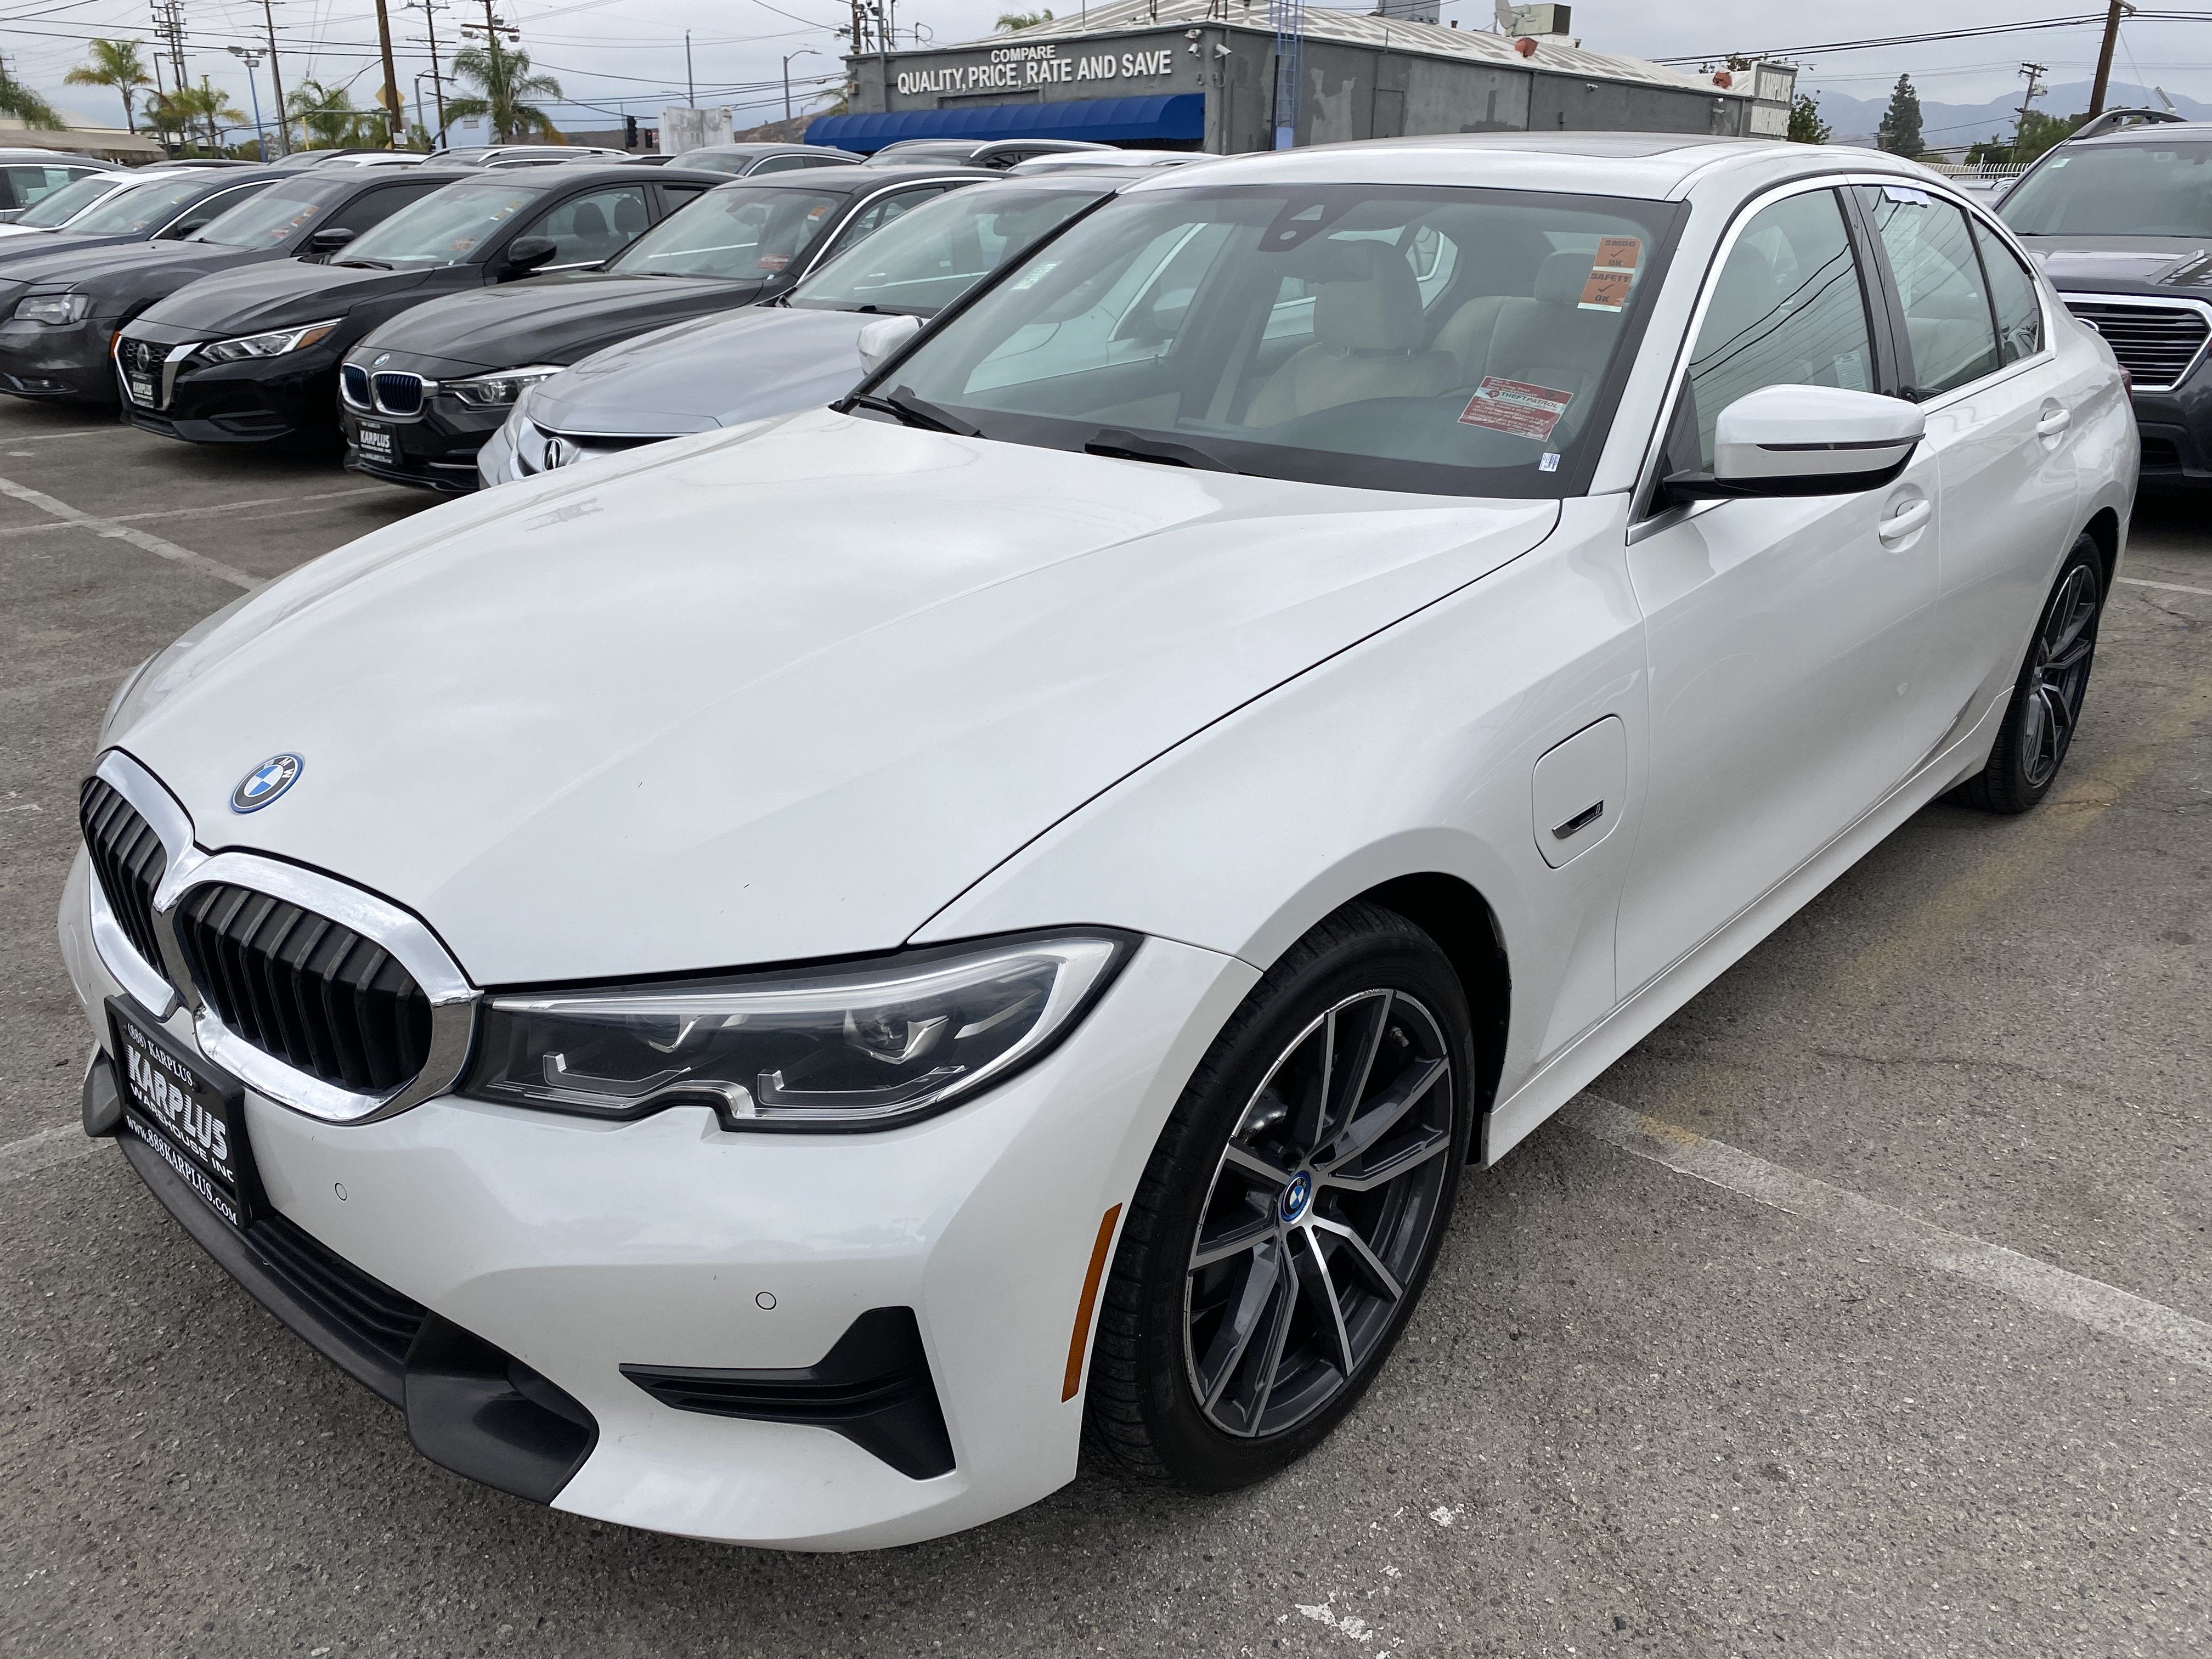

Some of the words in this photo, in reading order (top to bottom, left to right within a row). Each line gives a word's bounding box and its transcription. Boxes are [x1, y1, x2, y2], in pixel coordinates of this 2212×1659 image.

[991, 44, 1056, 63] COMPARE
[897, 67, 966, 95] QUALITY,
[968, 63, 1022, 89] PRICE,
[1026, 58, 1073, 84] RATE
[1077, 55, 1117, 81] AND
[1121, 50, 1172, 77] SAVE
[1759, 71, 1792, 103] KARPLUS
[1590, 273, 1629, 283] SAFETY
[360, 430, 390, 448] KARPLUS
[263, 757, 295, 778] BMW
[127, 1023, 146, 1049] (888)
[147, 1040, 193, 1086] KARPLUS
[127, 1044, 228, 1160] KARPLUS
[130, 1083, 208, 1163] WAREHOUSE
[212, 1157, 234, 1183] INC
